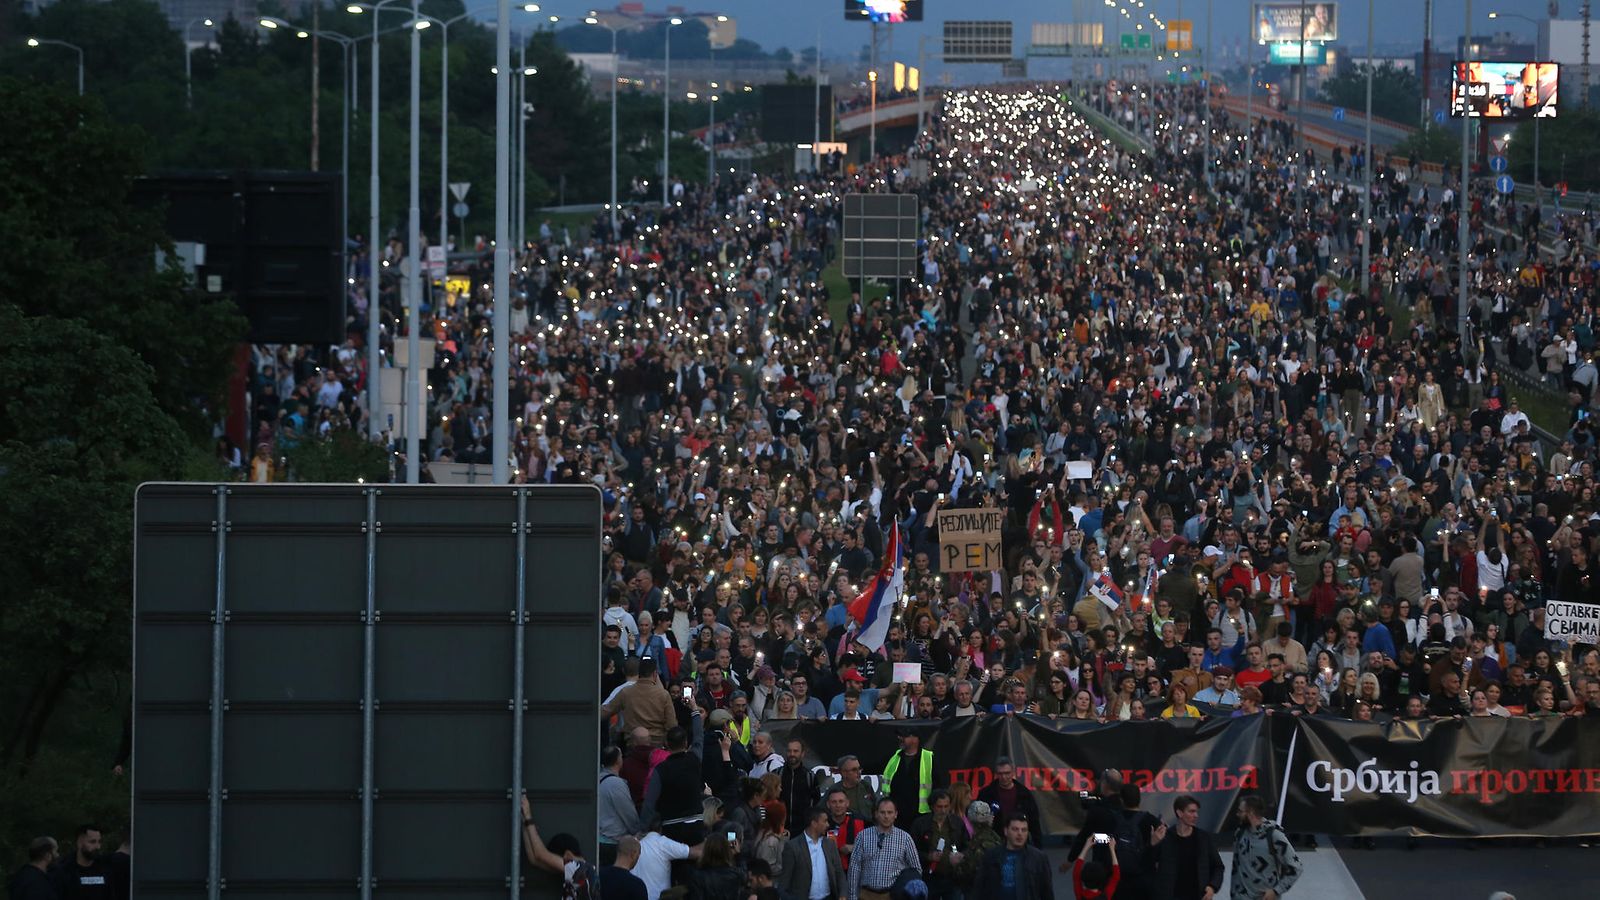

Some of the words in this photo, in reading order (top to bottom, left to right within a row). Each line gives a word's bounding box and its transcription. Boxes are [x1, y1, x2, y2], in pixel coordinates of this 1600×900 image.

[944, 542, 1001, 568] РЕМ
[1547, 603, 1600, 619] ОСТАВКЕ
[1548, 618, 1598, 636] СВИМА
[949, 766, 1097, 801] пртив
[1306, 757, 1442, 803] Србија
[1450, 768, 1600, 804] против
